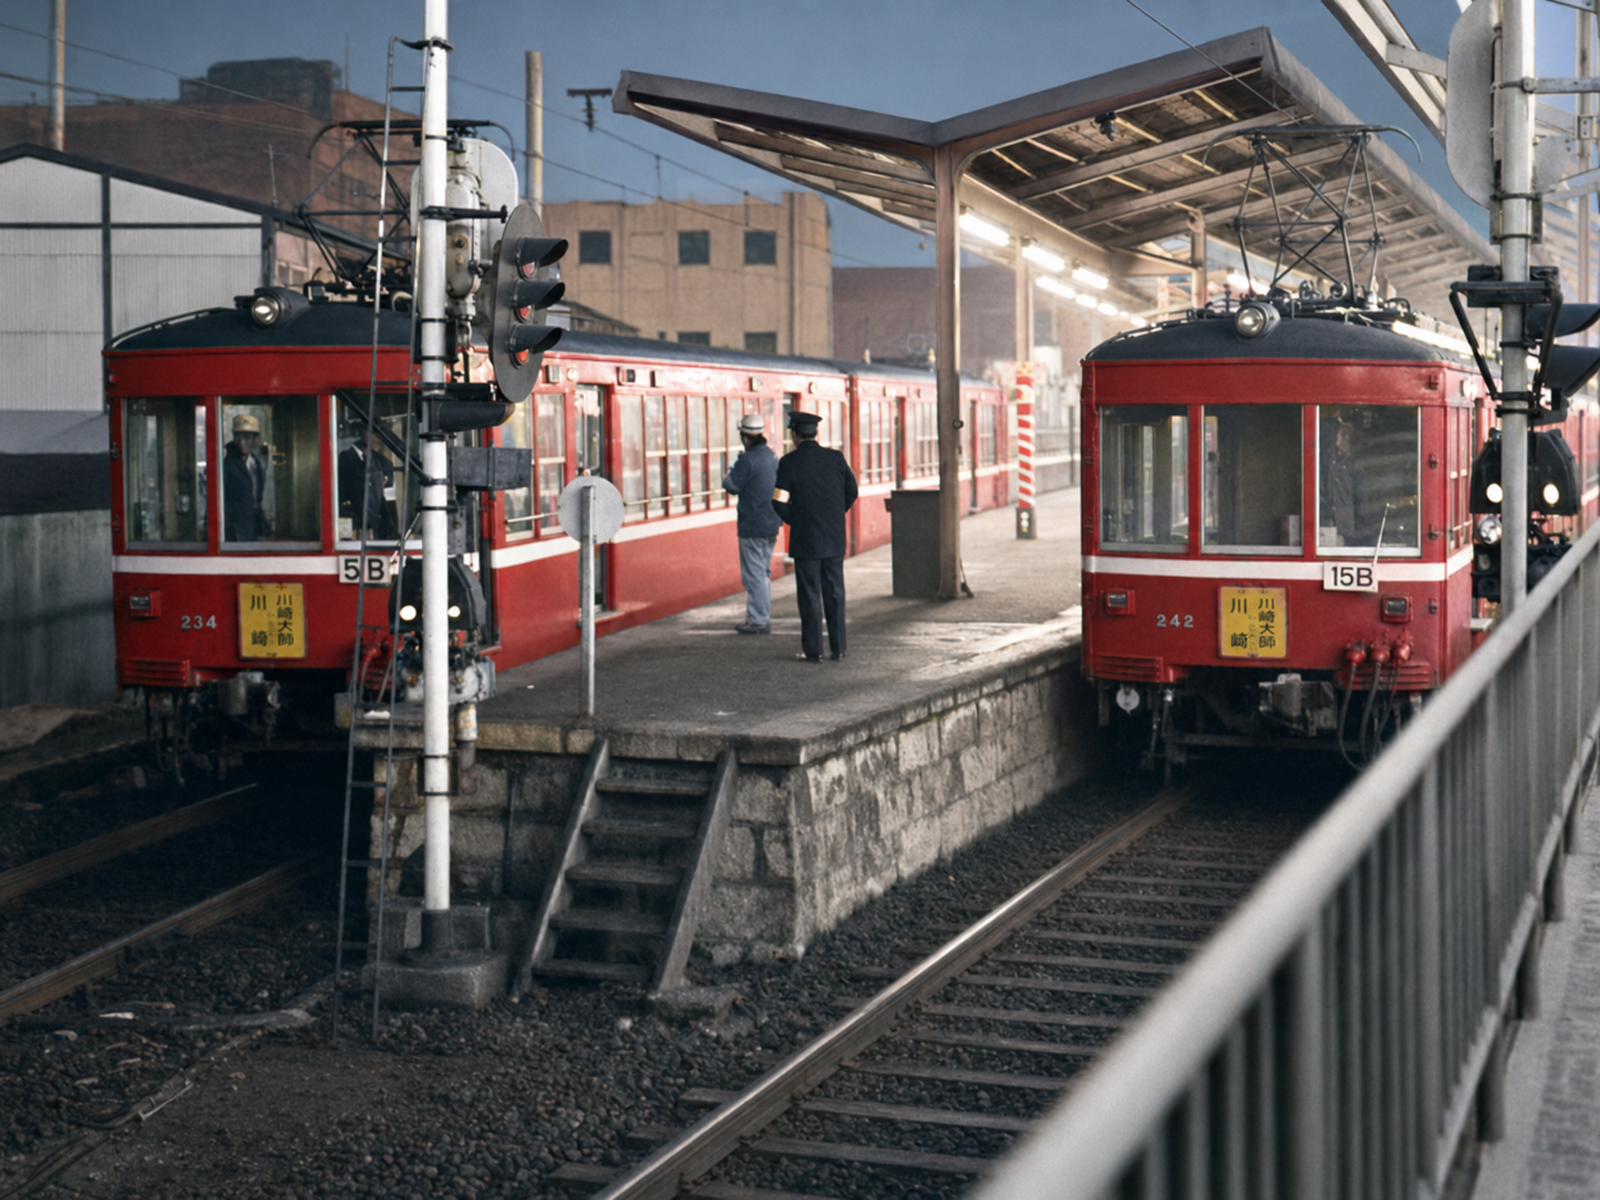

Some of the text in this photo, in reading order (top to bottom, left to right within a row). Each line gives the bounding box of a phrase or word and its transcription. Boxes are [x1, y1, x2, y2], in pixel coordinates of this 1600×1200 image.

[344, 558, 384, 581] 5B
[1331, 566, 1373, 587] 15B
[181, 614, 217, 630] 234
[1156, 613, 1194, 628] 242
